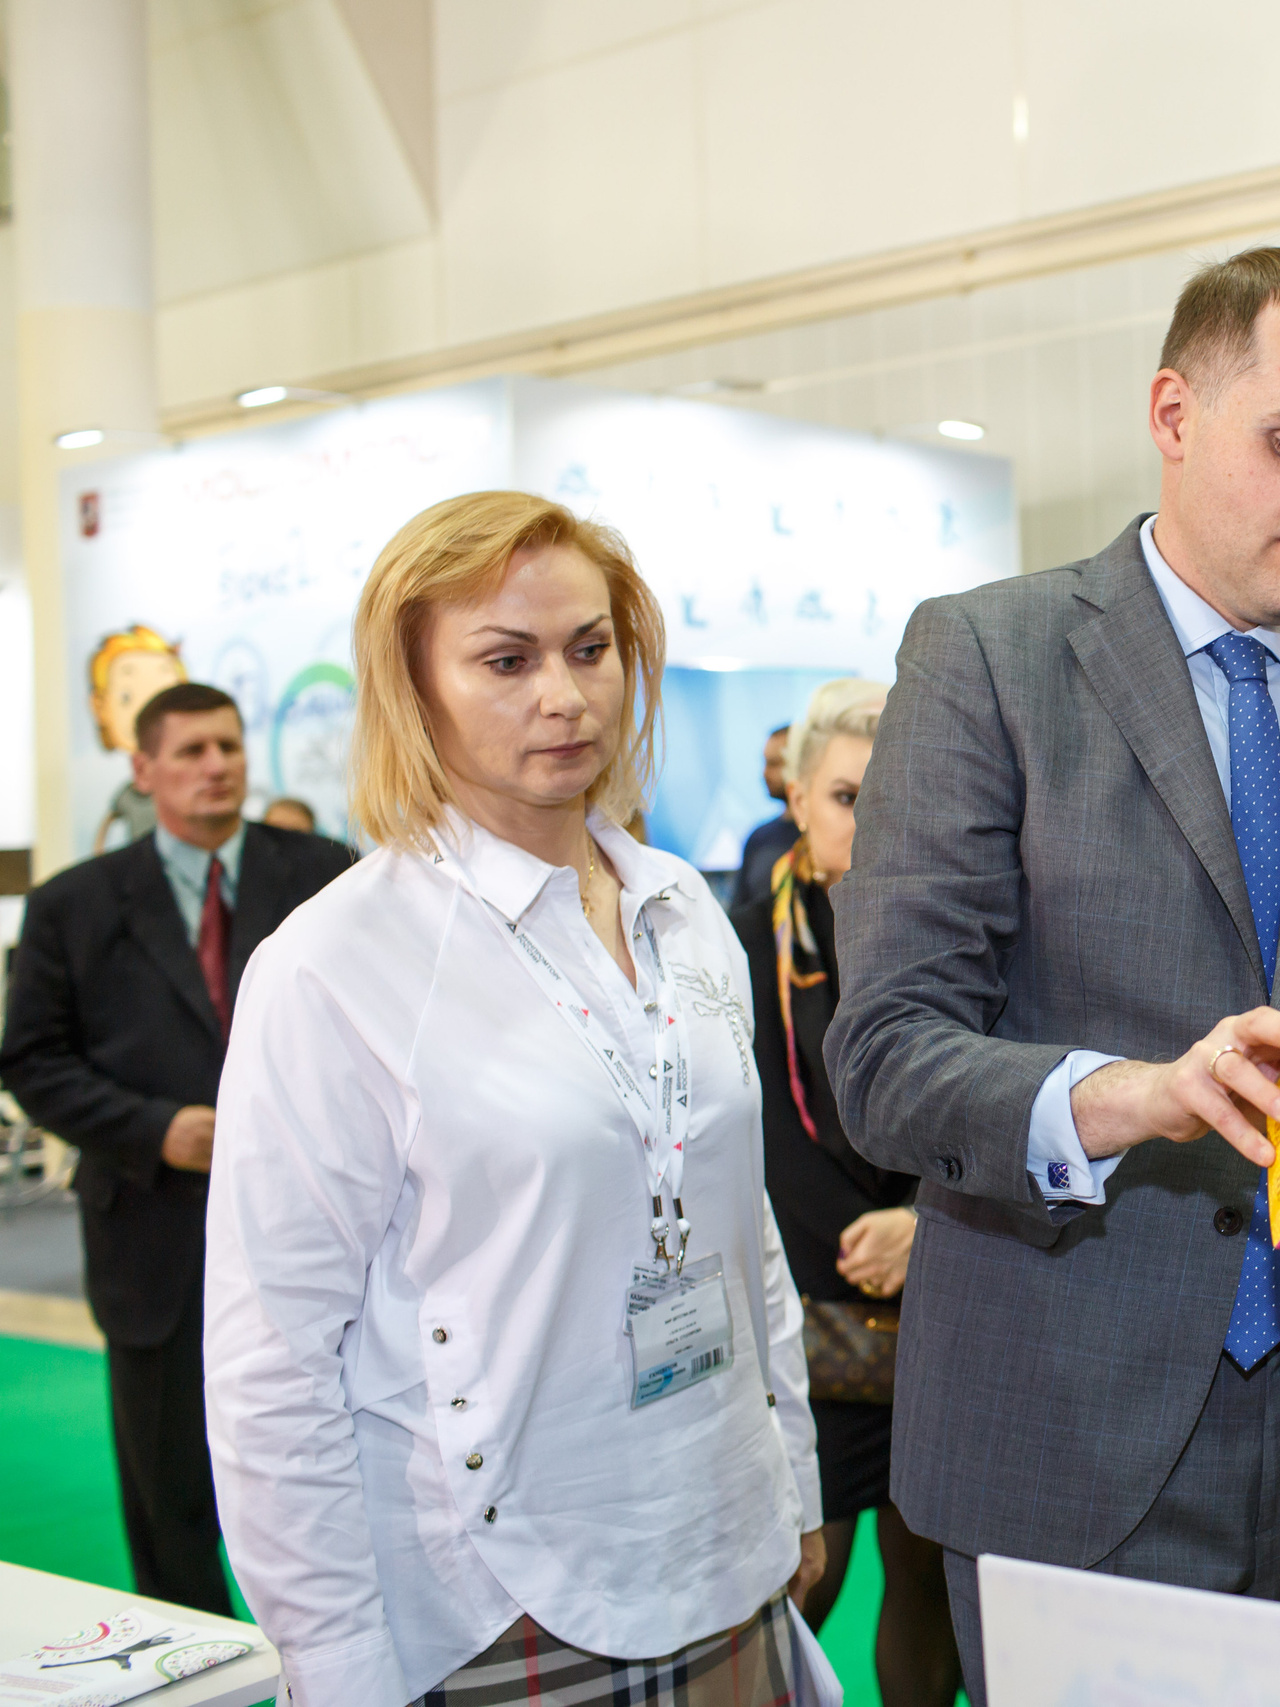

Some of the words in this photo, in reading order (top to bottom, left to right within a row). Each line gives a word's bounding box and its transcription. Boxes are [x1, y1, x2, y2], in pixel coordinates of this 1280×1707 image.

[514, 934, 540, 963] РОССИИ
[520, 932, 561, 981] МИНПРОМТОРГ
[611, 1061, 635, 1091] РОССИИ
[616, 1059, 652, 1110] МИНПРОМТОРГ
